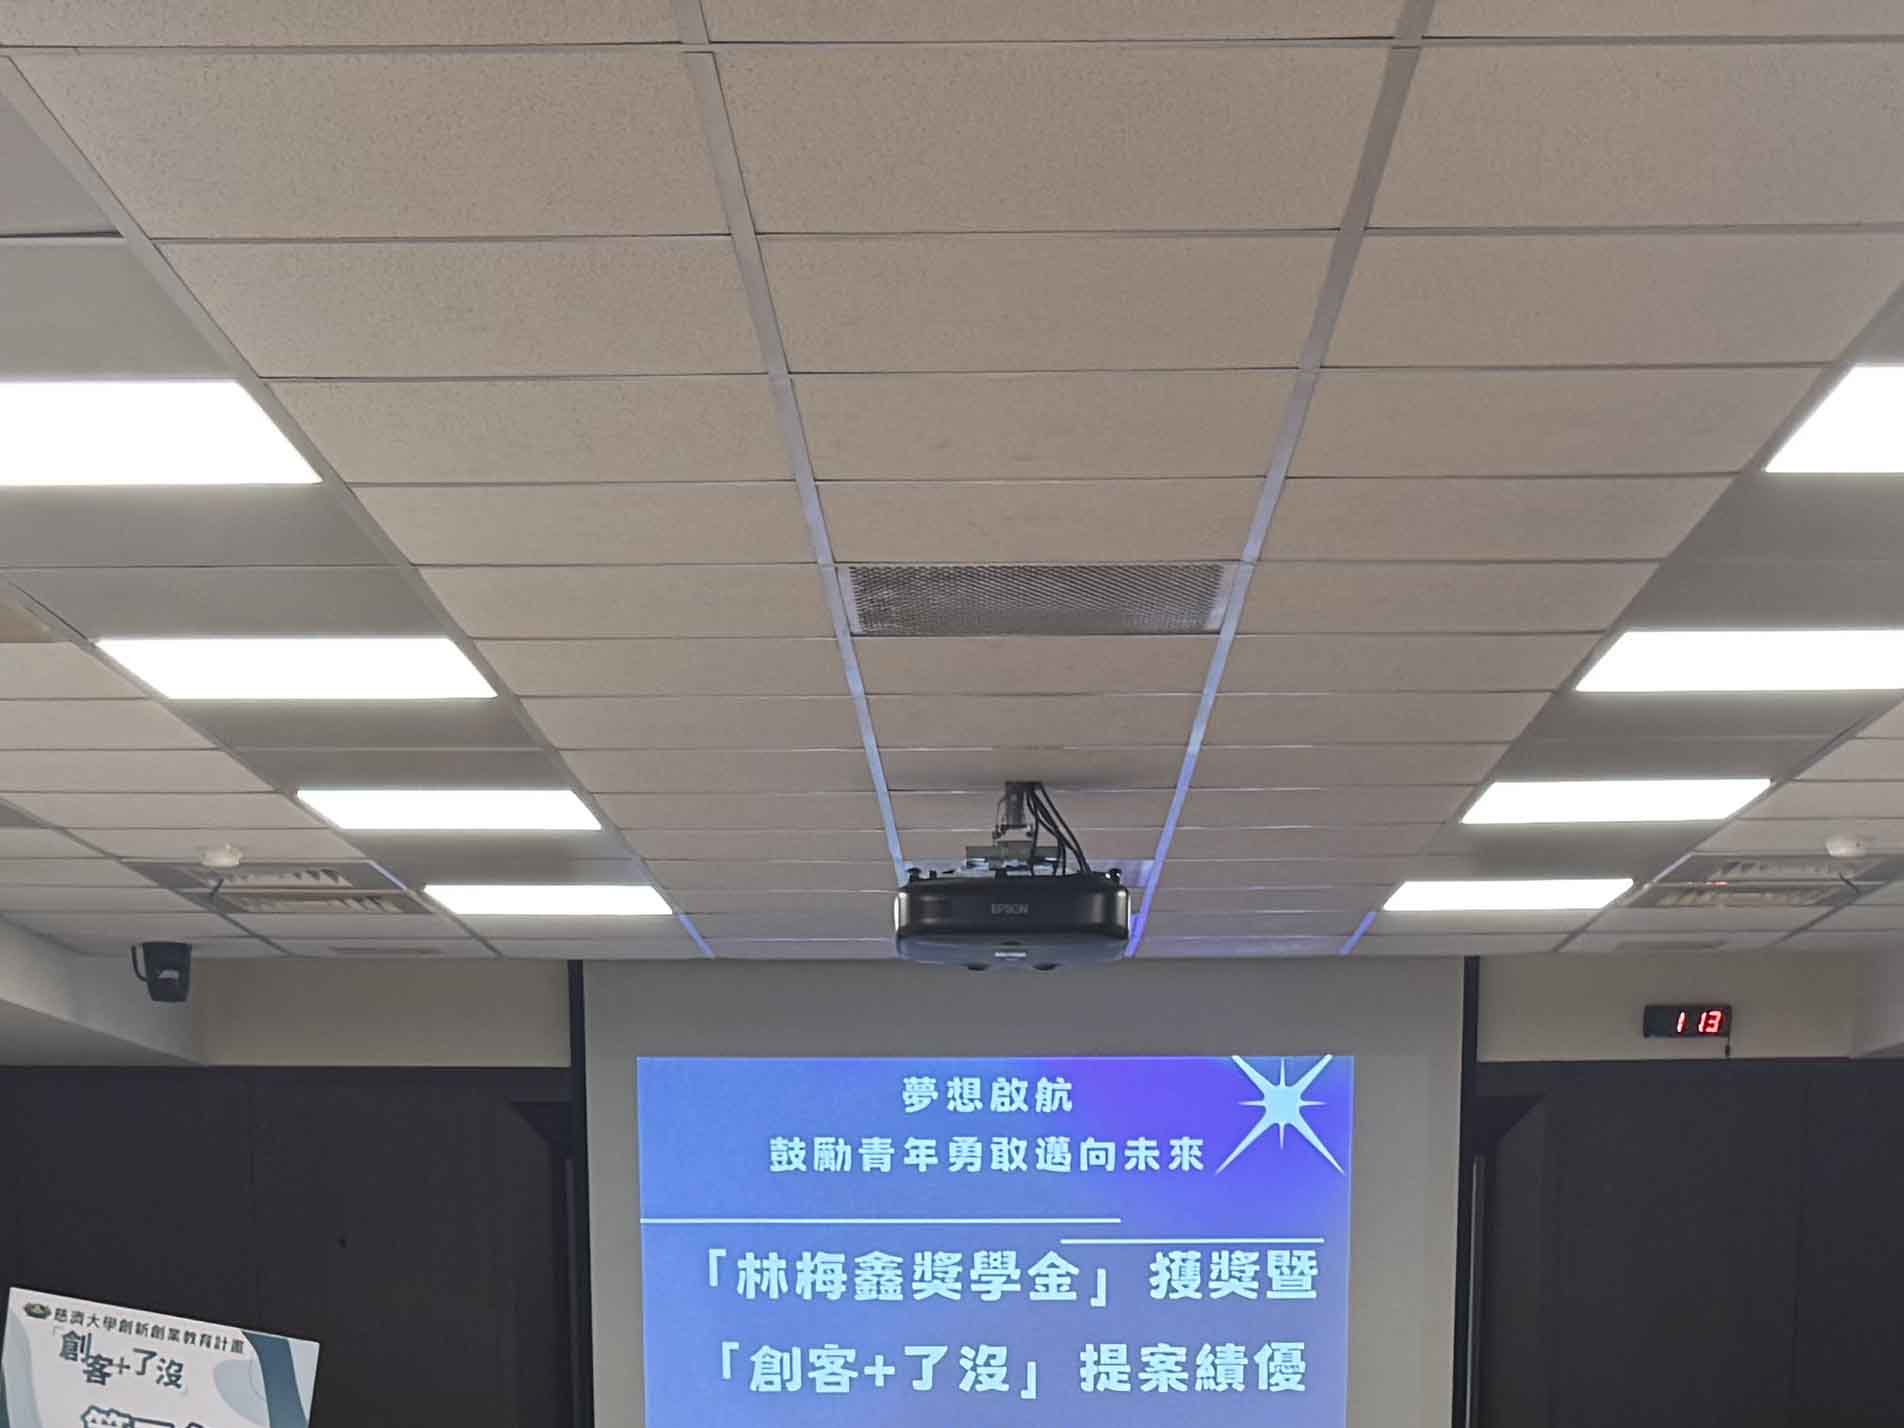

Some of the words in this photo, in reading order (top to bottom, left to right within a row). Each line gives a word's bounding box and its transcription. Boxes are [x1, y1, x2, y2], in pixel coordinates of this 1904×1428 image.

[902, 1076, 1074, 1113] 夢想啟航
[769, 1136, 1205, 1173] 鼓勵青年勇敢邁向未來
